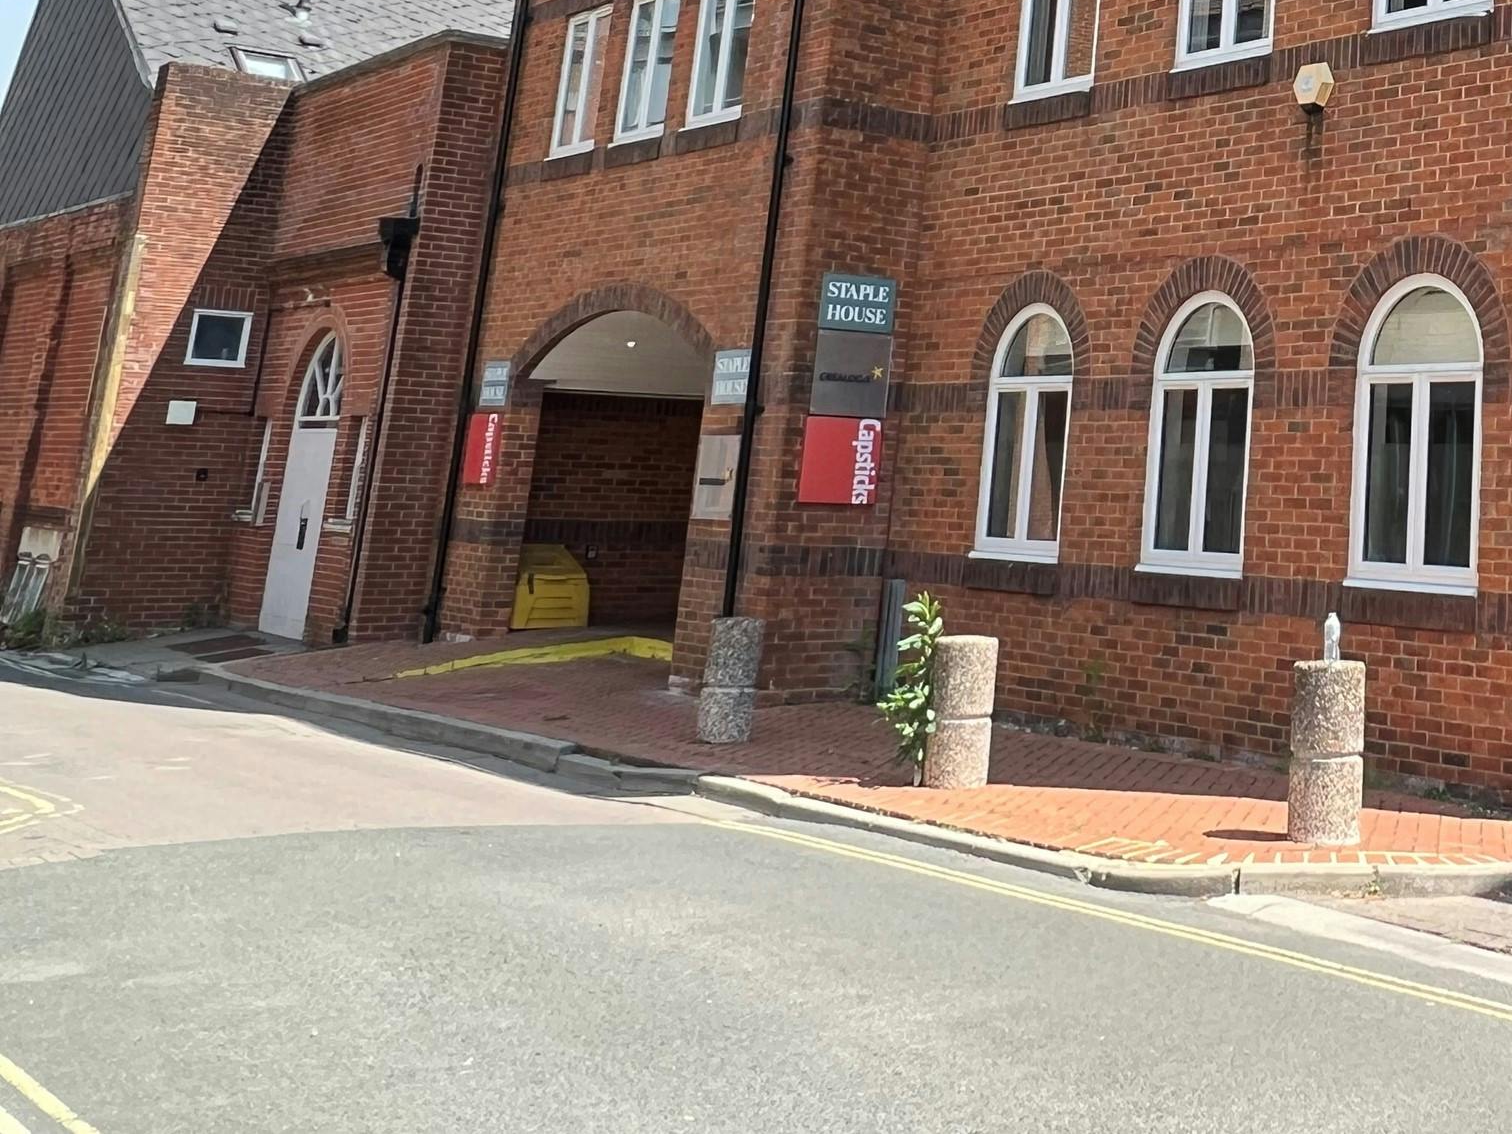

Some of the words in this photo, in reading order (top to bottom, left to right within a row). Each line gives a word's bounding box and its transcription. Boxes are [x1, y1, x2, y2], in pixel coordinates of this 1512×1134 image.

[827, 281, 890, 303] STAPLE
[826, 304, 887, 325] HOUSE
[851, 418, 881, 505] Capsticks
